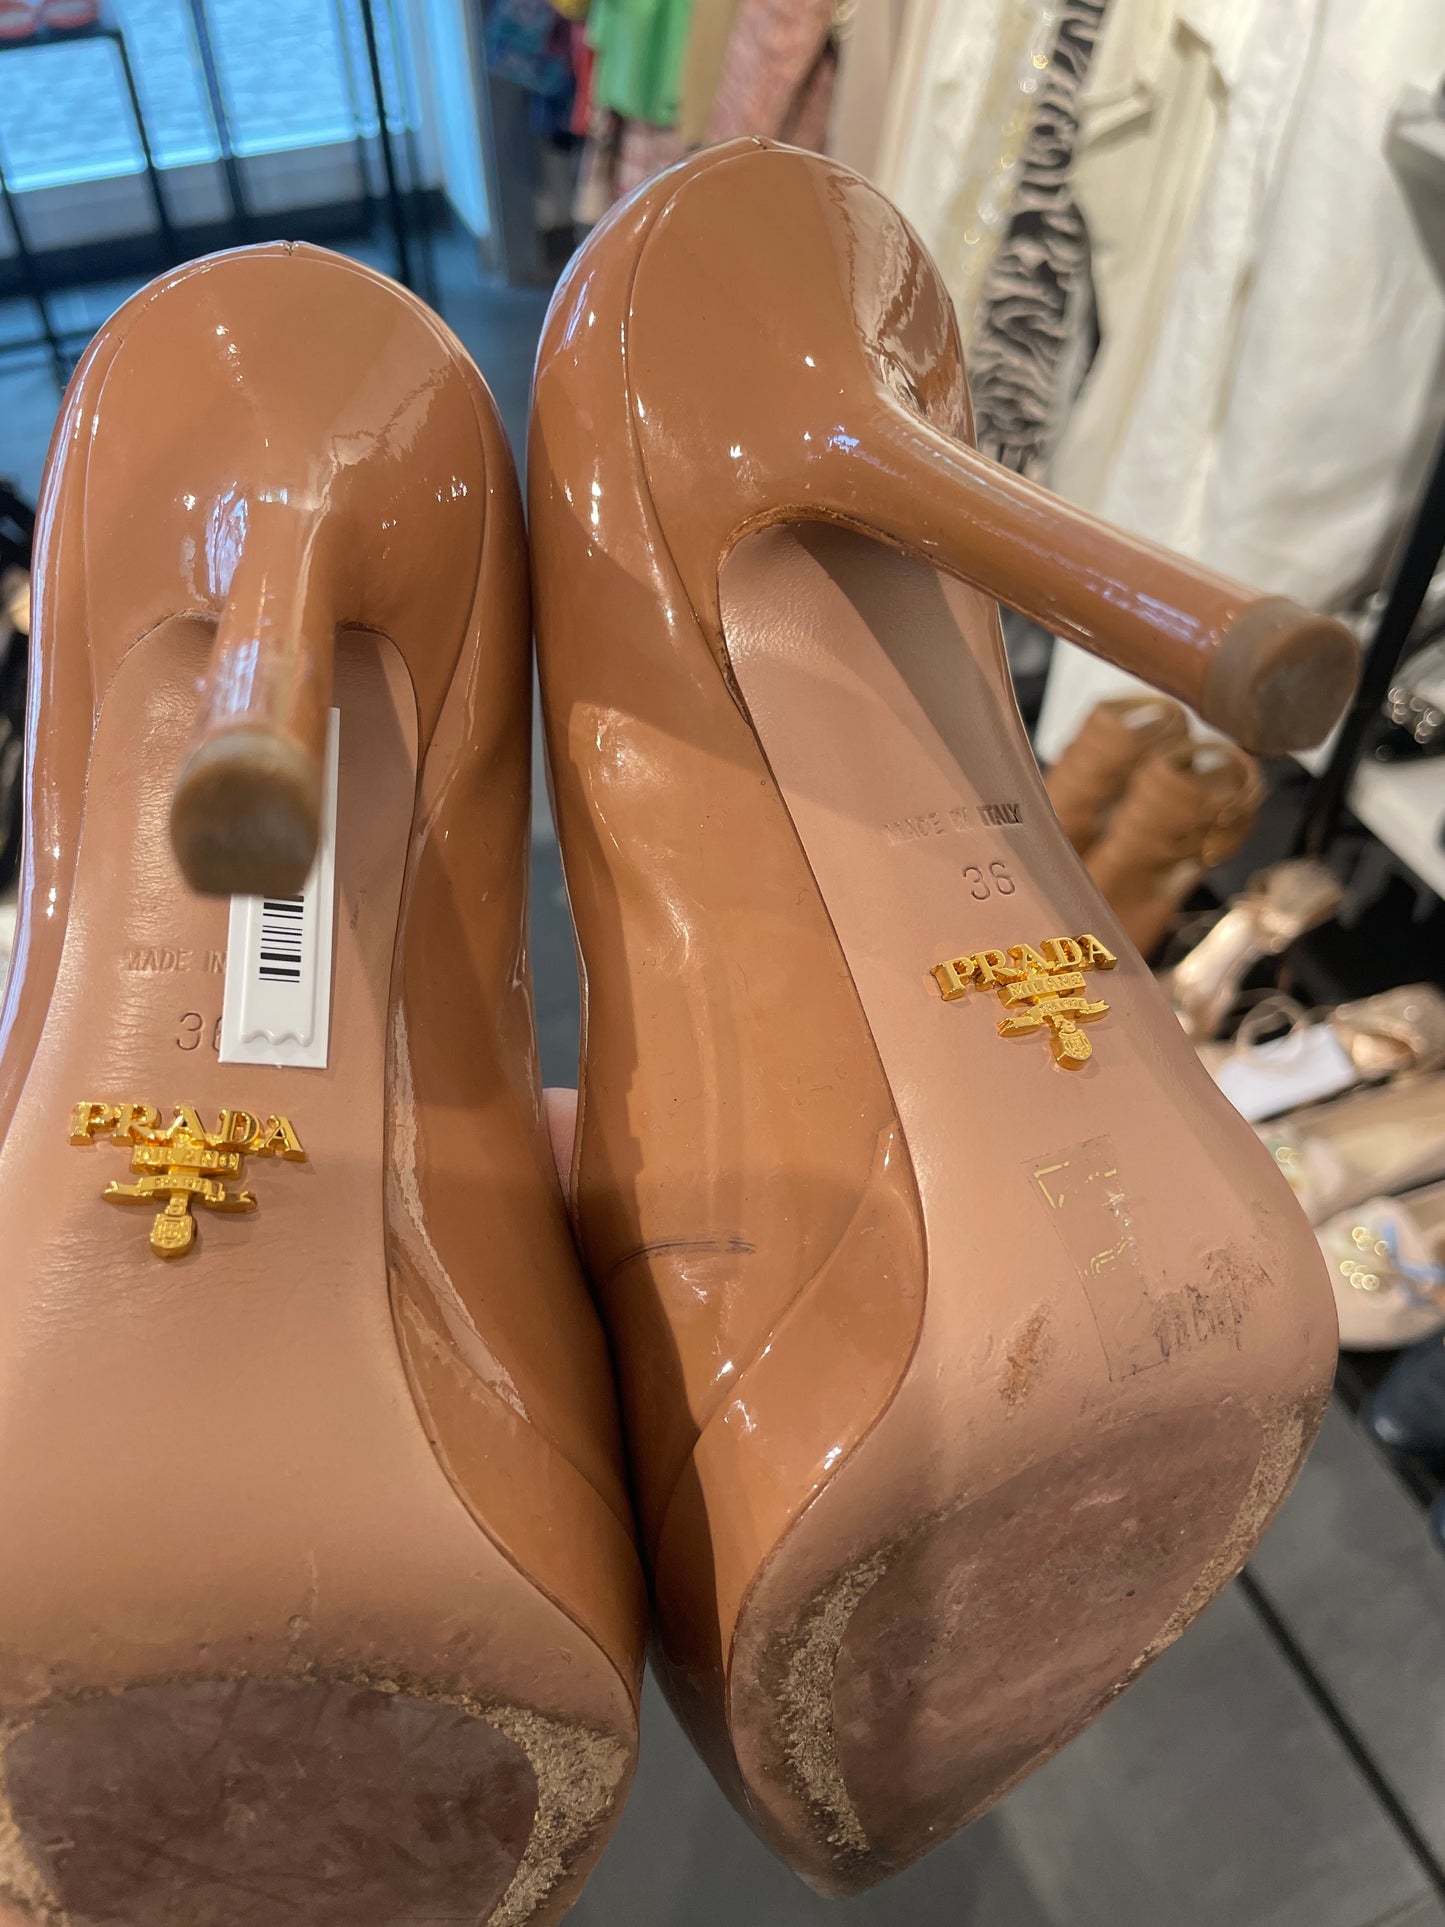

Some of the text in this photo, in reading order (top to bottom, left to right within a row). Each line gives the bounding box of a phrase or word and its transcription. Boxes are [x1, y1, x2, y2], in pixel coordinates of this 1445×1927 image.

[976, 802, 1025, 827] ITALY
[962, 861, 1016, 901] 36
[124, 948, 194, 973] MADE
[930, 934, 1118, 1000] PRADA
[1005, 971, 1086, 999] MILANO
[70, 1101, 308, 1162] PRADA
